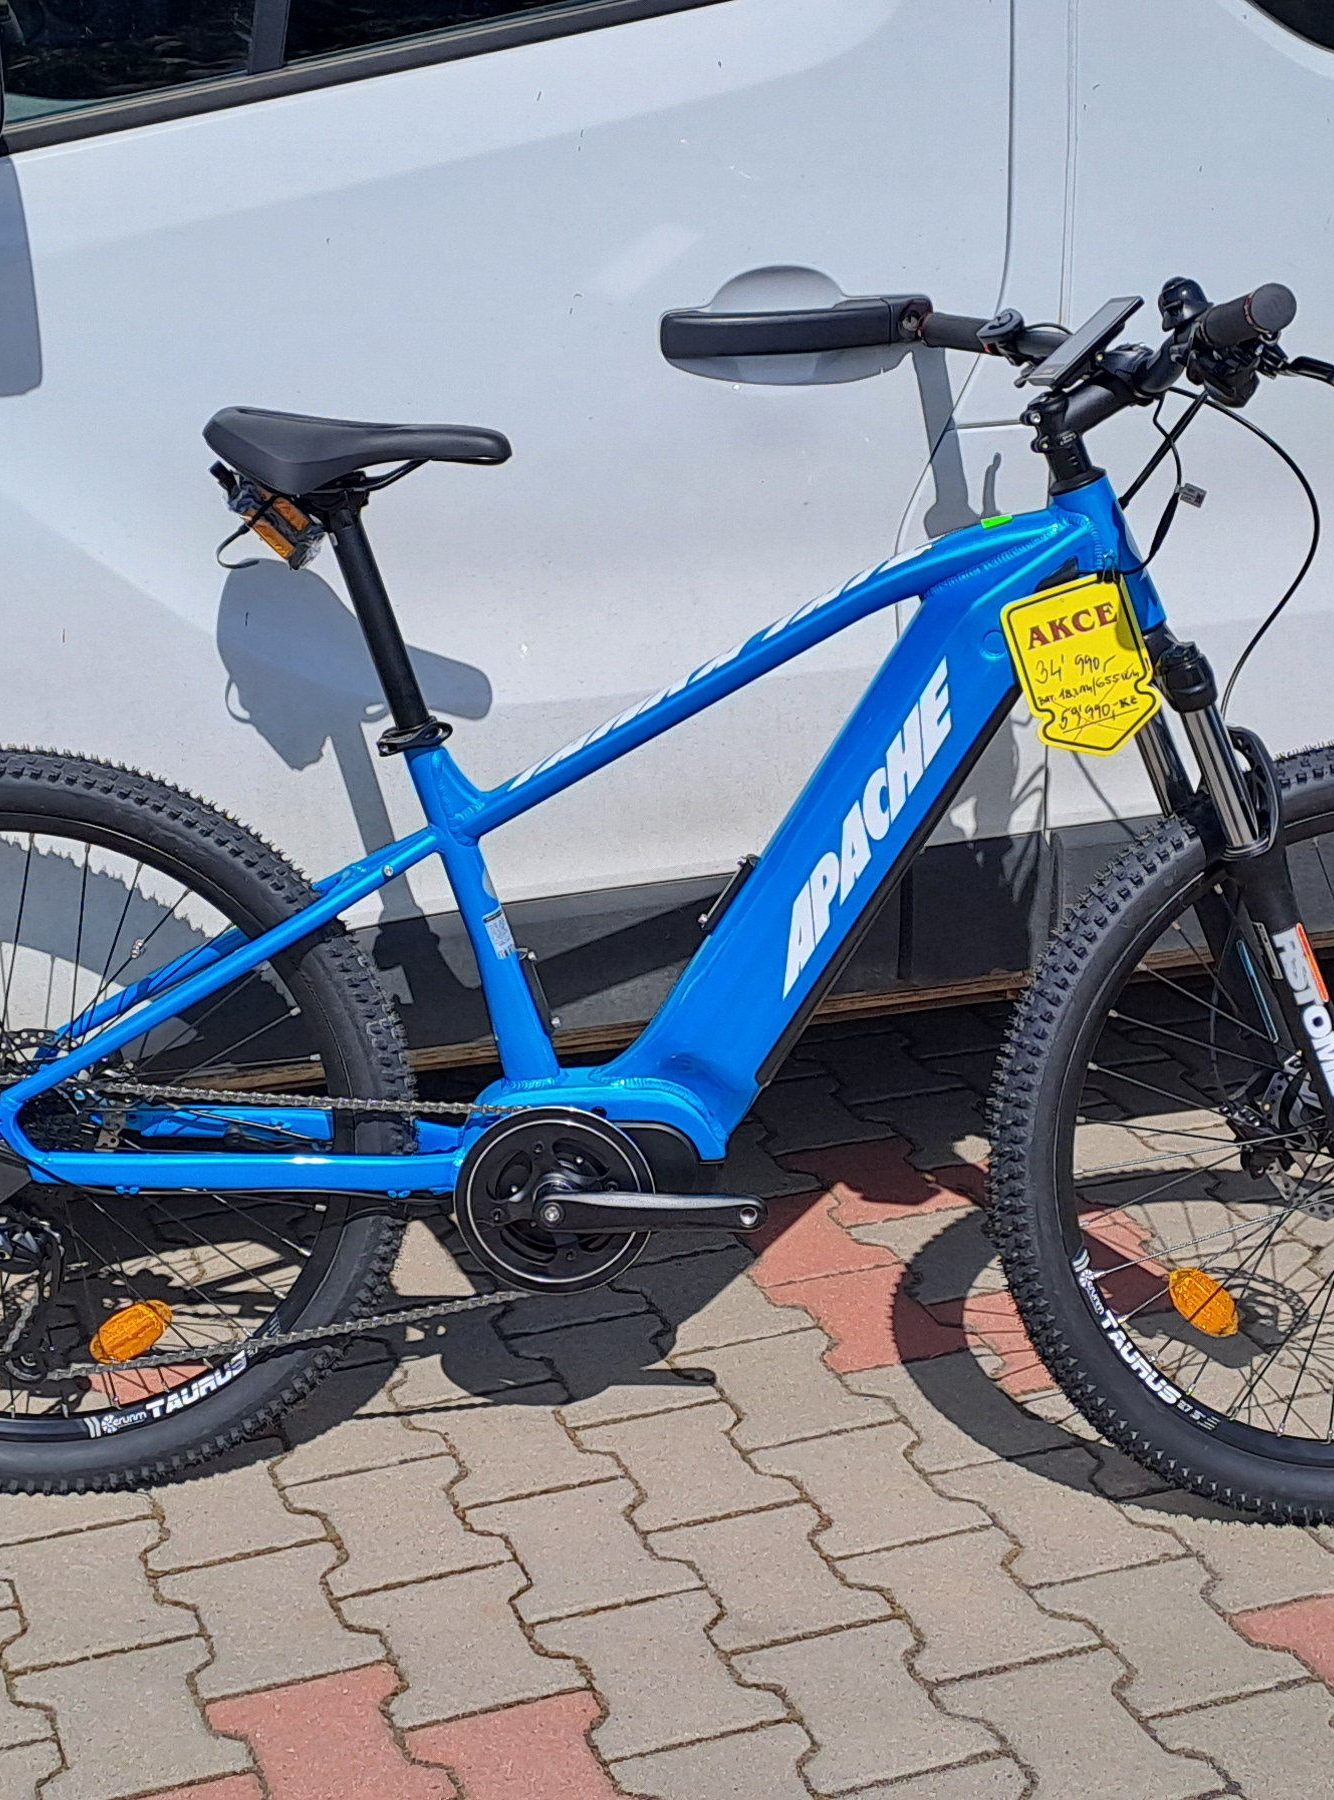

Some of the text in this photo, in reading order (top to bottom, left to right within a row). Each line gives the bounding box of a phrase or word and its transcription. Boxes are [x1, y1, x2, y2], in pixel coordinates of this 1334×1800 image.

[1027, 601, 1118, 650] AKCE
[782, 655, 952, 1001] APACHE
[145, 1349, 248, 1418] TAURUS
[1101, 1309, 1182, 1405] TAURUS
